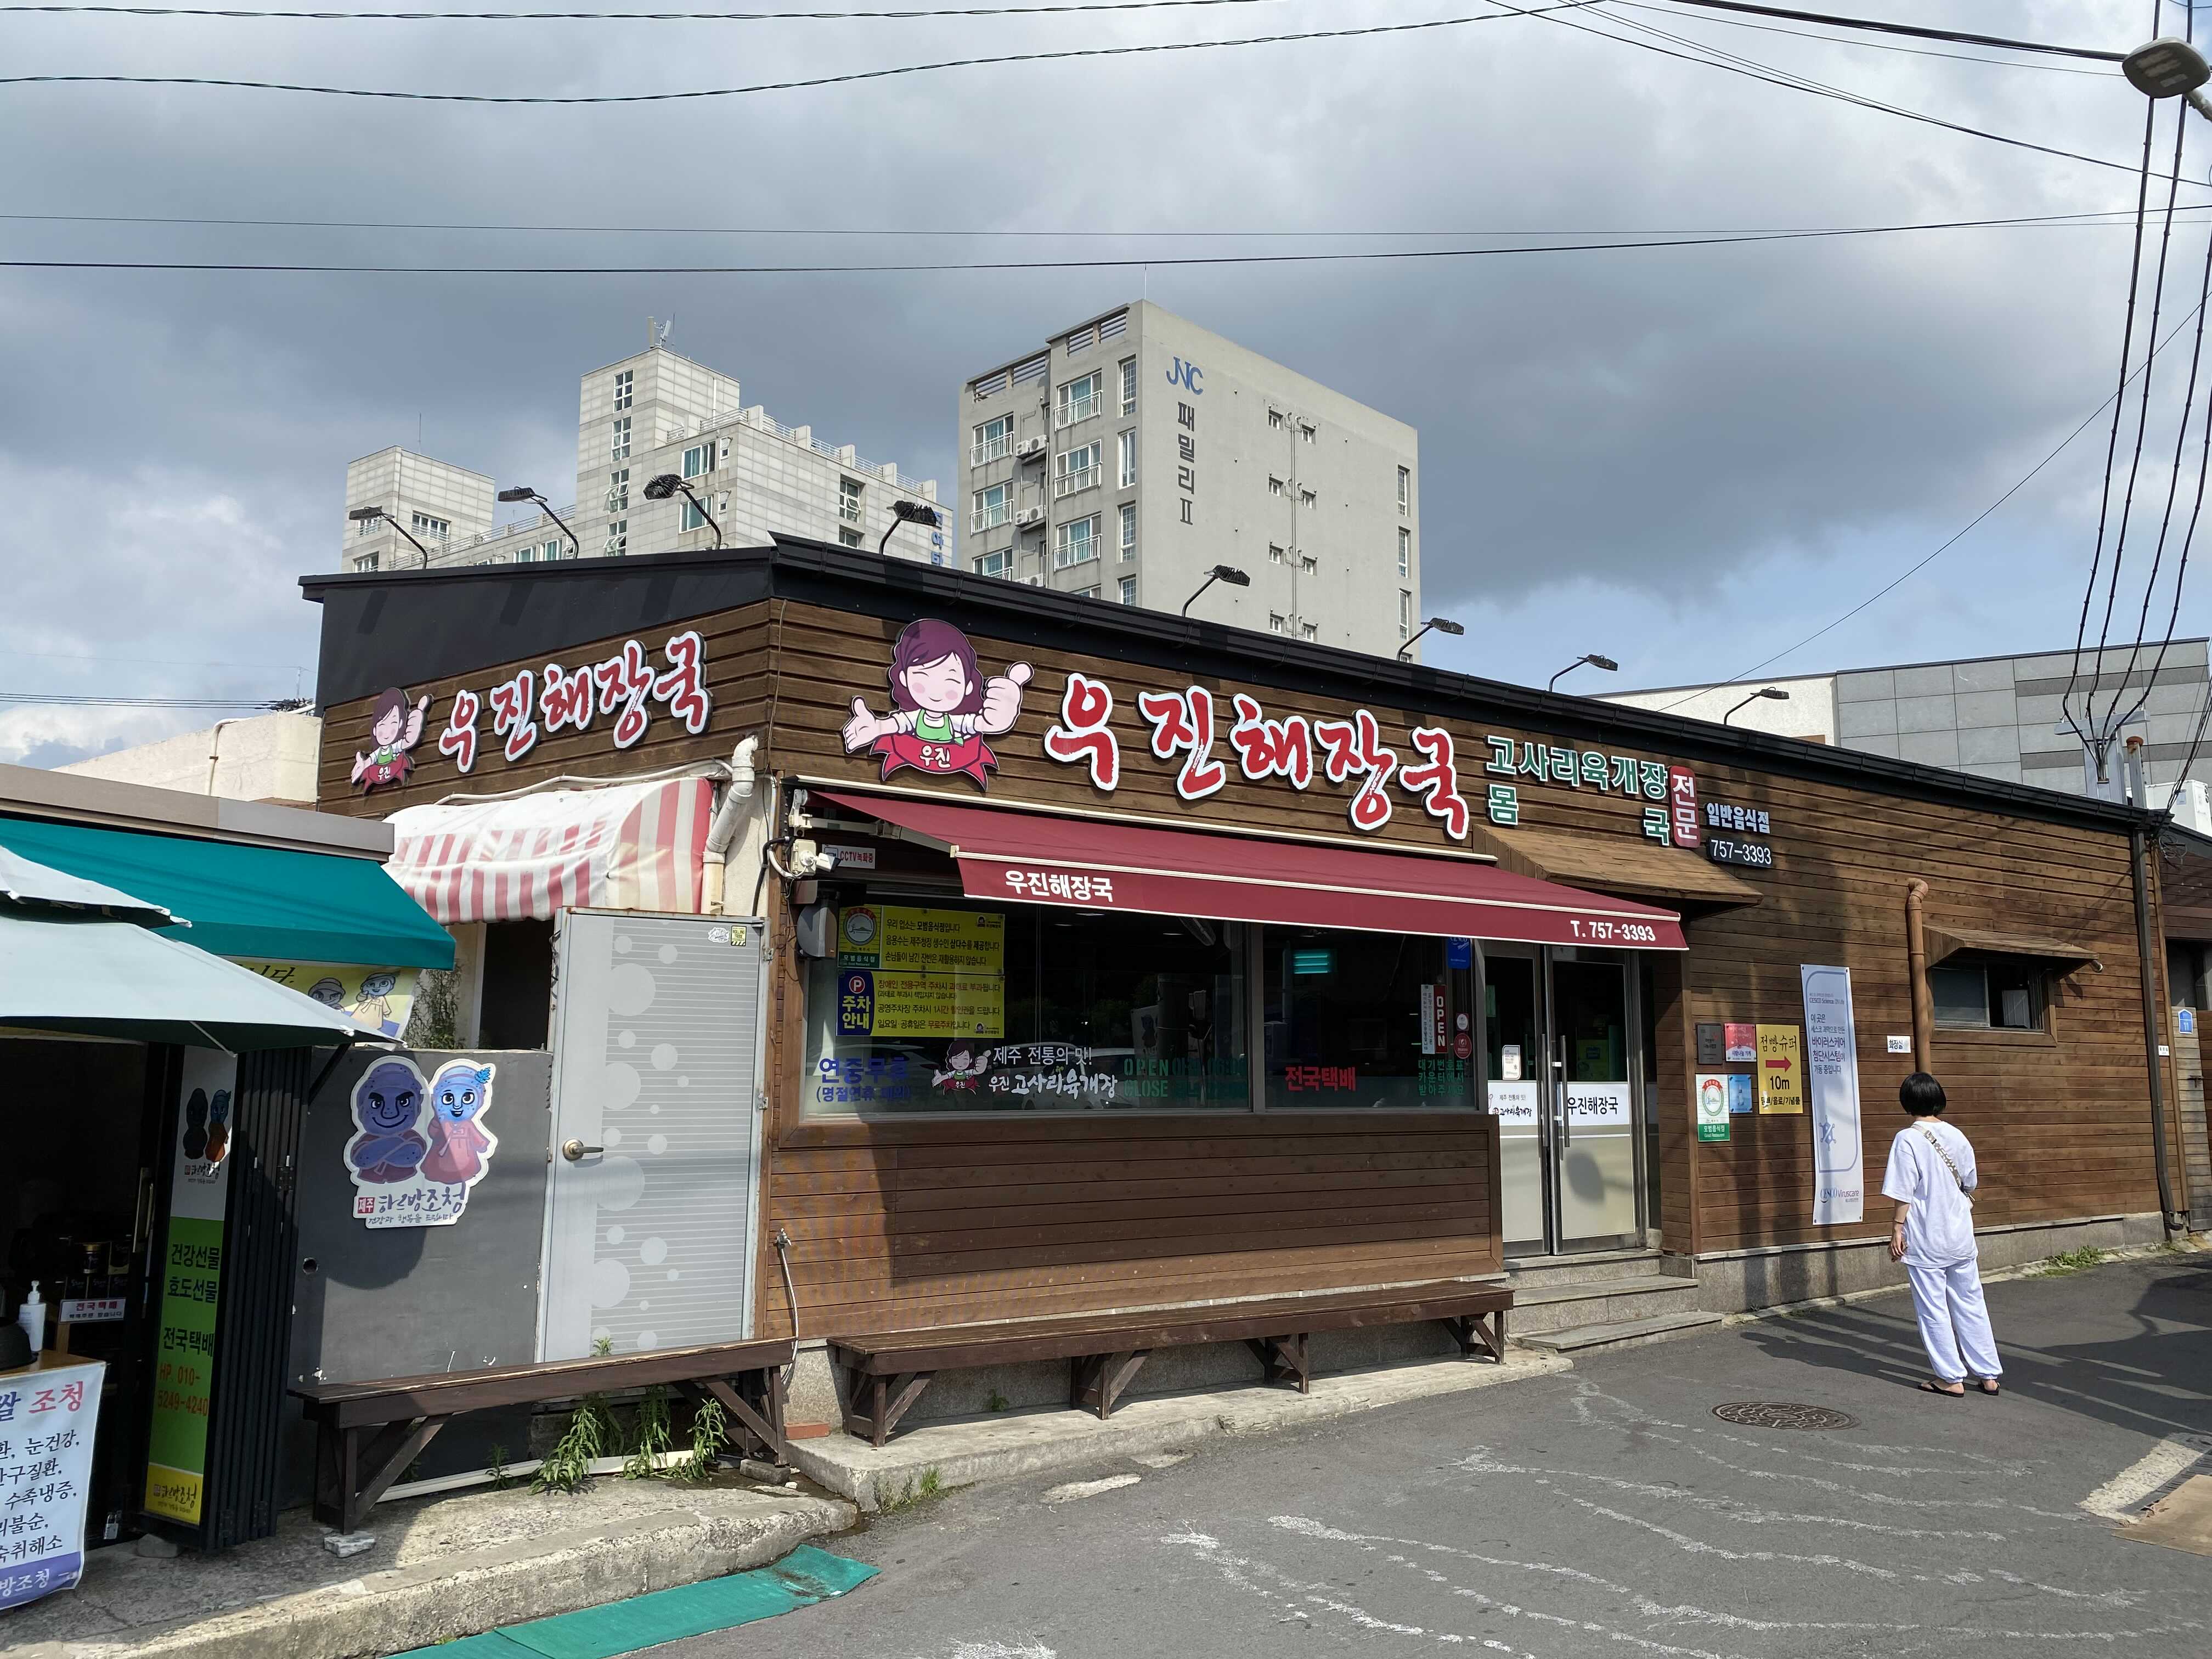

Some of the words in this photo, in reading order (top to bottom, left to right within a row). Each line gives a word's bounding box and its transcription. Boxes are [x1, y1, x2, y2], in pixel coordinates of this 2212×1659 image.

[1166, 357, 1203, 396] JNC
[439, 631, 710, 773] 우진해장국
[919, 745, 951, 769] 우진
[1045, 673, 1470, 840] 우진해장국
[1486, 735, 1668, 800] 고사리육개장
[377, 766, 391, 781] 우진
[1673, 774, 1697, 840] 전문
[1707, 803, 1771, 834] 일반음식점
[1711, 839, 1772, 865] 757-3393
[1005, 870, 1113, 902] 우진해장국
[1570, 920, 1586, 938] T.
[1589, 921, 1656, 942] 757-3393
[842, 996, 871, 1012] 주차
[842, 1013, 870, 1030] 안내
[1437, 996, 1446, 1047] OPEN
[1812, 1036, 1846, 1048] 바이러스케어
[993, 1046, 1022, 1065] 제주
[1028, 1047, 1069, 1065] 전통의
[1075, 1047, 1092, 1065] 맛!
[1124, 1059, 1169, 1076] OPEN
[989, 1076, 1010, 1092] 우진
[1011, 1069, 1118, 1099] 고사리육개장
[1285, 1066, 1356, 1091] 전국택배
[1770, 1076, 1790, 1090] 10m
[1567, 1097, 1618, 1115] 우진해장국
[358, 1198, 375, 1213] 제주
[368, 1215, 394, 1224] 건강과
[397, 1214, 422, 1223] 행복을
[171, 1244, 220, 1271] 건강선물
[167, 1276, 218, 1304] 효도선물
[163, 1327, 215, 1357] 전국택배
[29, 1381, 84, 1414] 조청
